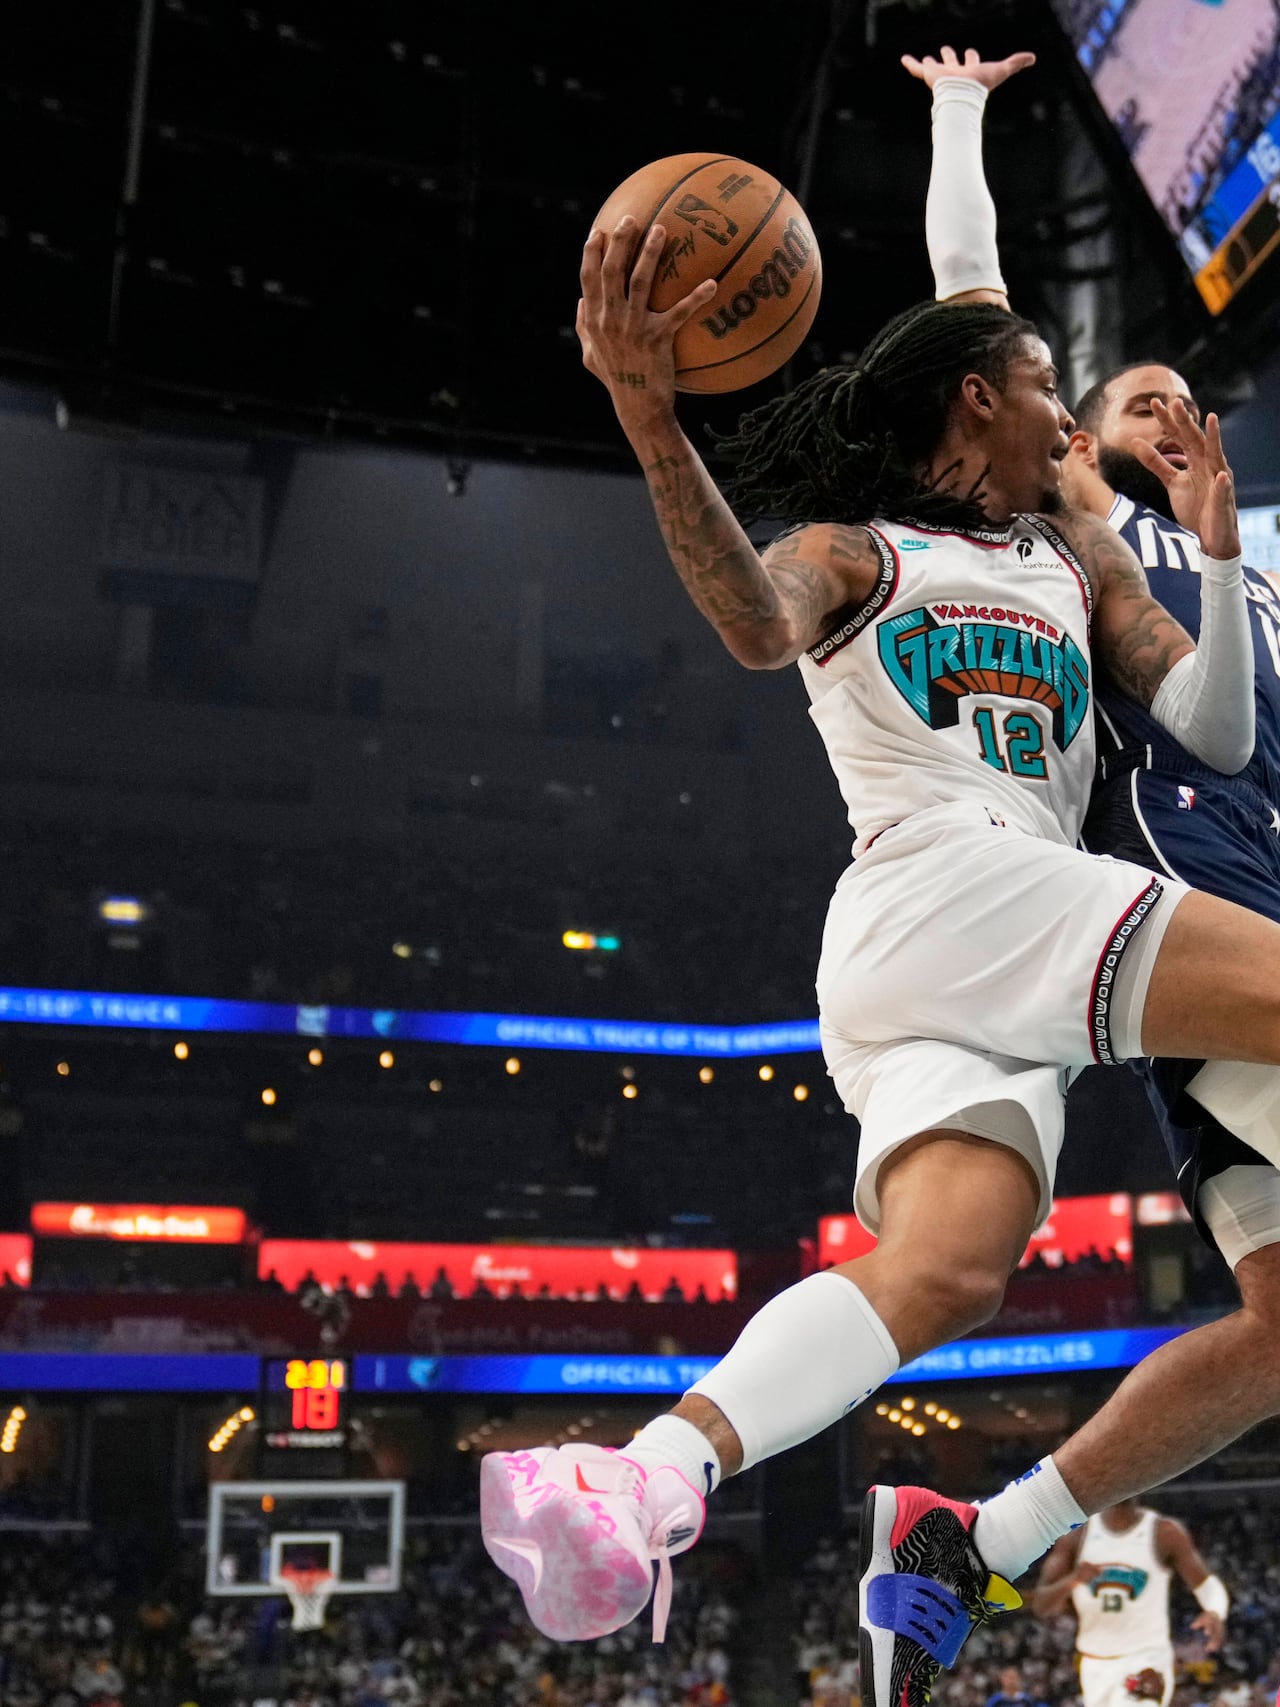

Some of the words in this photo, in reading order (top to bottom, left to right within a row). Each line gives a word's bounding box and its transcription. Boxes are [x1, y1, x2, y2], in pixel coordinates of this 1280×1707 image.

[702, 216, 815, 339] Wilson
[932, 604, 1060, 641] VANCOUVER
[876, 607, 1089, 753] GRIZZLIES
[972, 706, 1049, 782] 12
[496, 1019, 588, 1046] OFFICIAL
[592, 1024, 658, 1048] TRUCK
[969, 1341, 1095, 1369] GRIZZLIES
[562, 1363, 671, 1386] OFFICIAL
